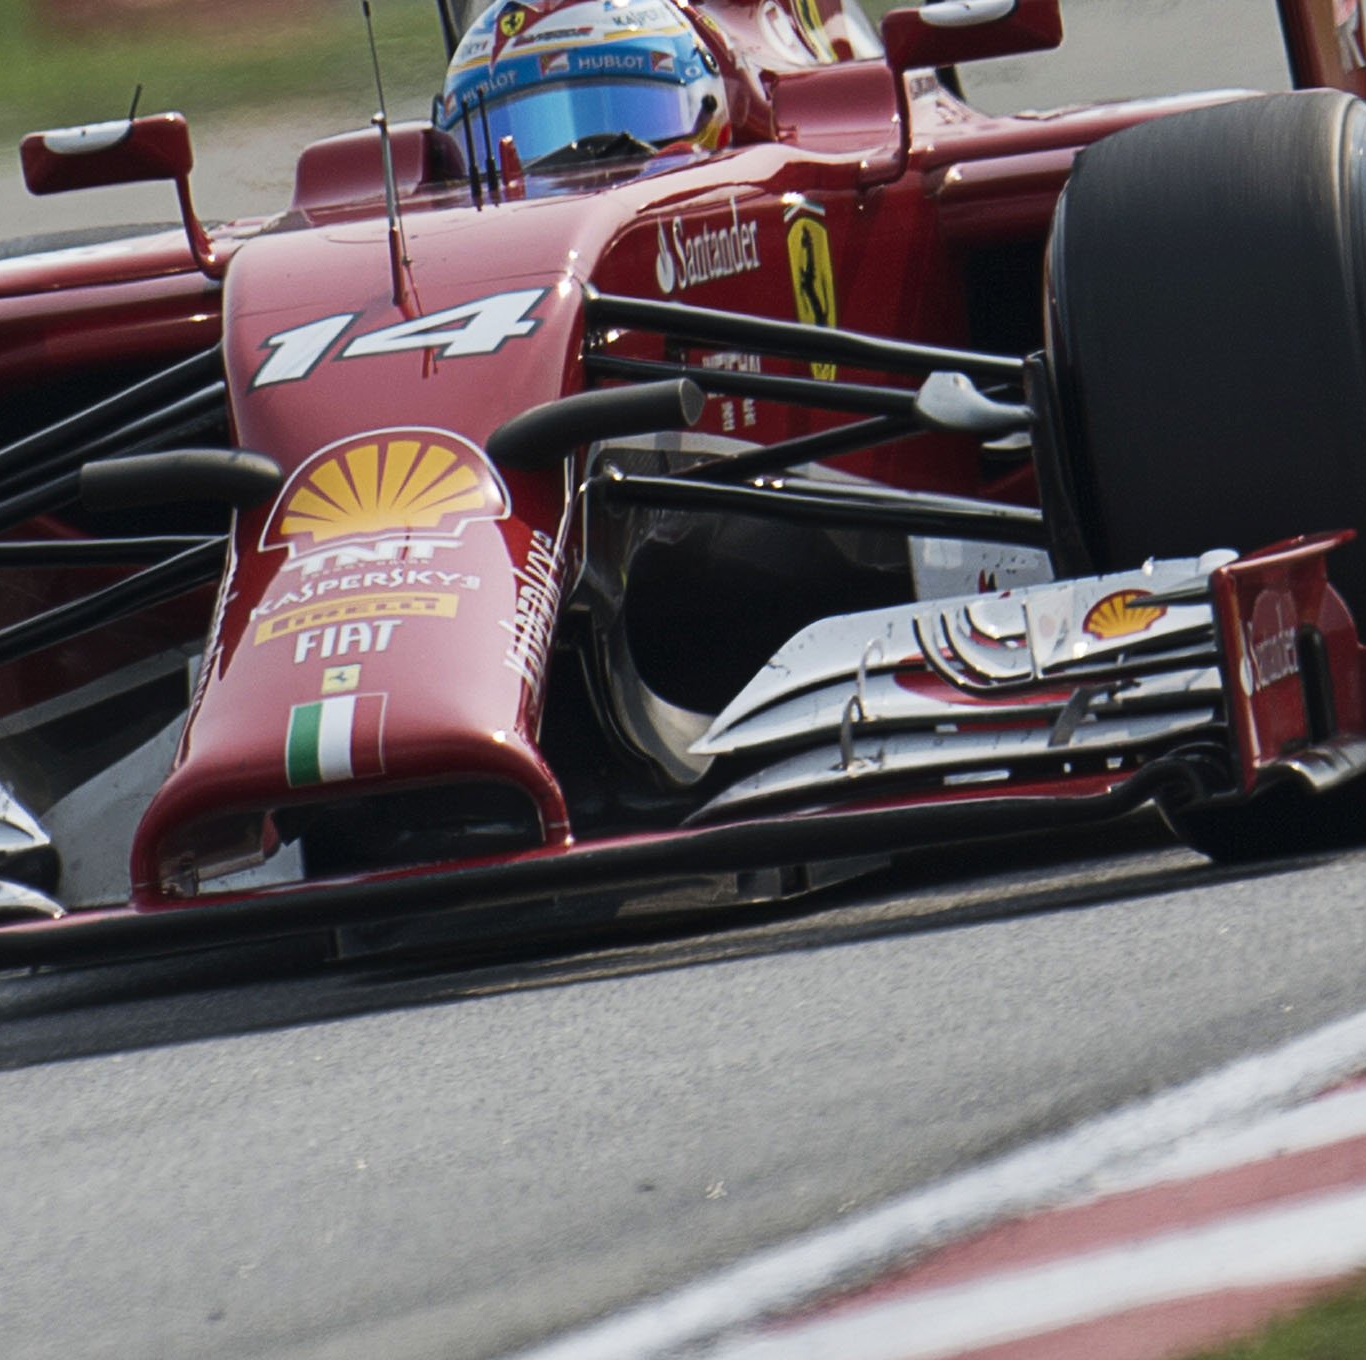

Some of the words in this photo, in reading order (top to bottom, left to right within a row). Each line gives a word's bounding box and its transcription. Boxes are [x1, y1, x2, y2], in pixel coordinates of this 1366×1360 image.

[578, 54, 644, 70] HUBLOT
[673, 196, 760, 290] Santander
[249, 287, 549, 390] 14
[280, 540, 464, 578] TNT
[294, 620, 402, 664] FIAT
